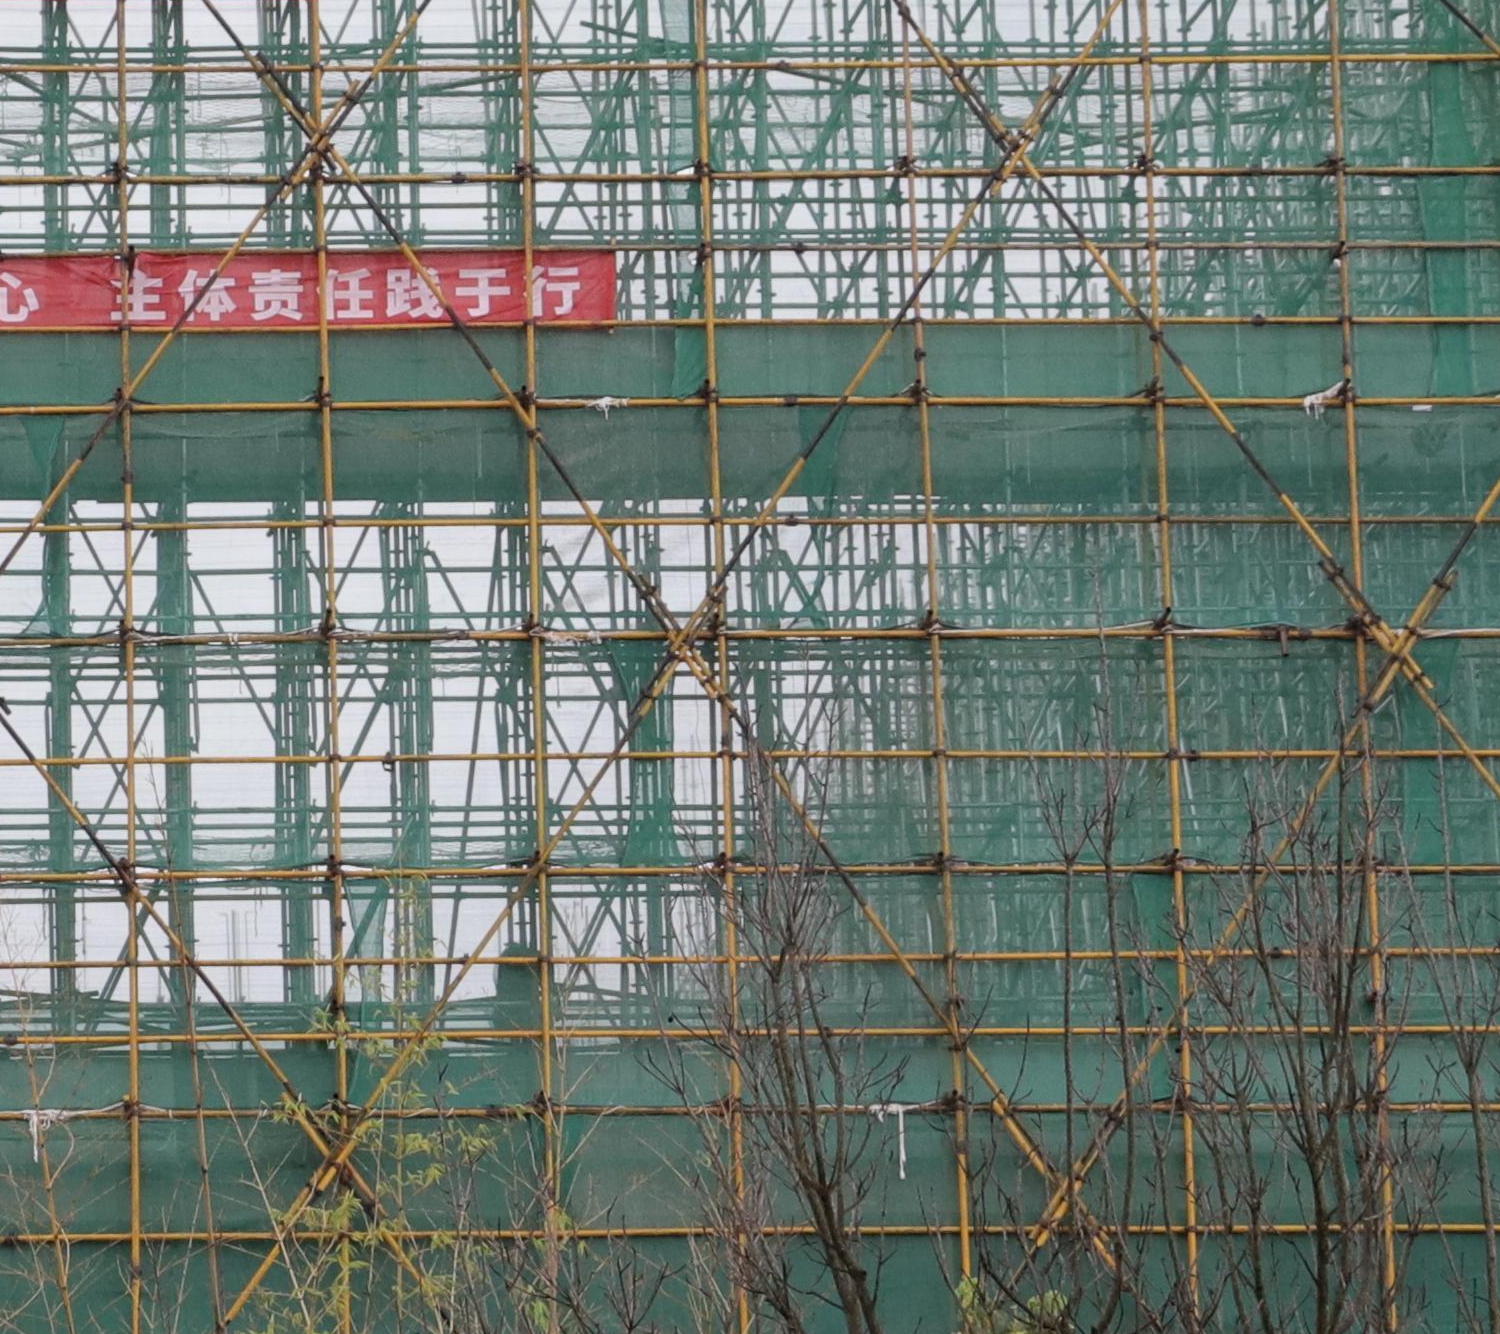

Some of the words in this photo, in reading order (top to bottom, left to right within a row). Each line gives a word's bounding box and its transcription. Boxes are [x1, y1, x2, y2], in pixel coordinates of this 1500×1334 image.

[110, 266, 581, 322] 主体责任践于行
